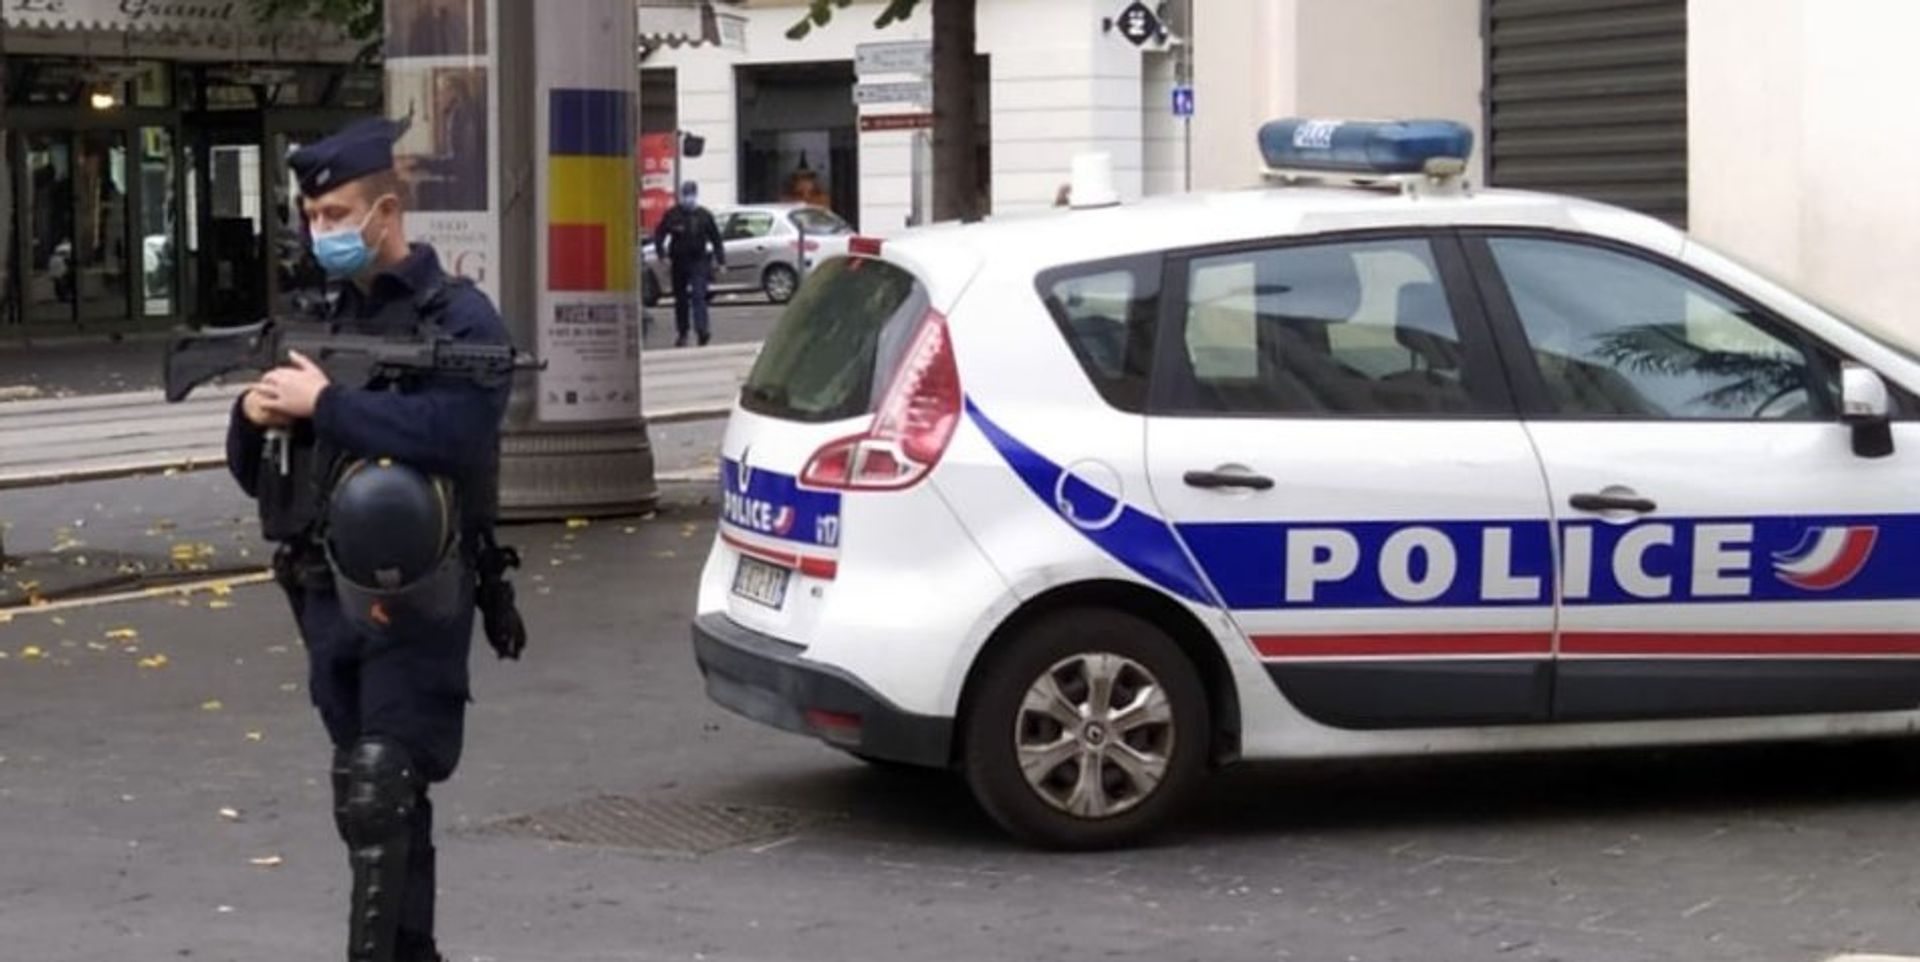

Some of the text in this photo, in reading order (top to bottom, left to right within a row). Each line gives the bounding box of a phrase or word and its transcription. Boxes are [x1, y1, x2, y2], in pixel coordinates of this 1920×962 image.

[120, 0, 233, 19] Grand
[724, 491, 771, 531] POLICE
[1285, 523, 1754, 602] POLICE
